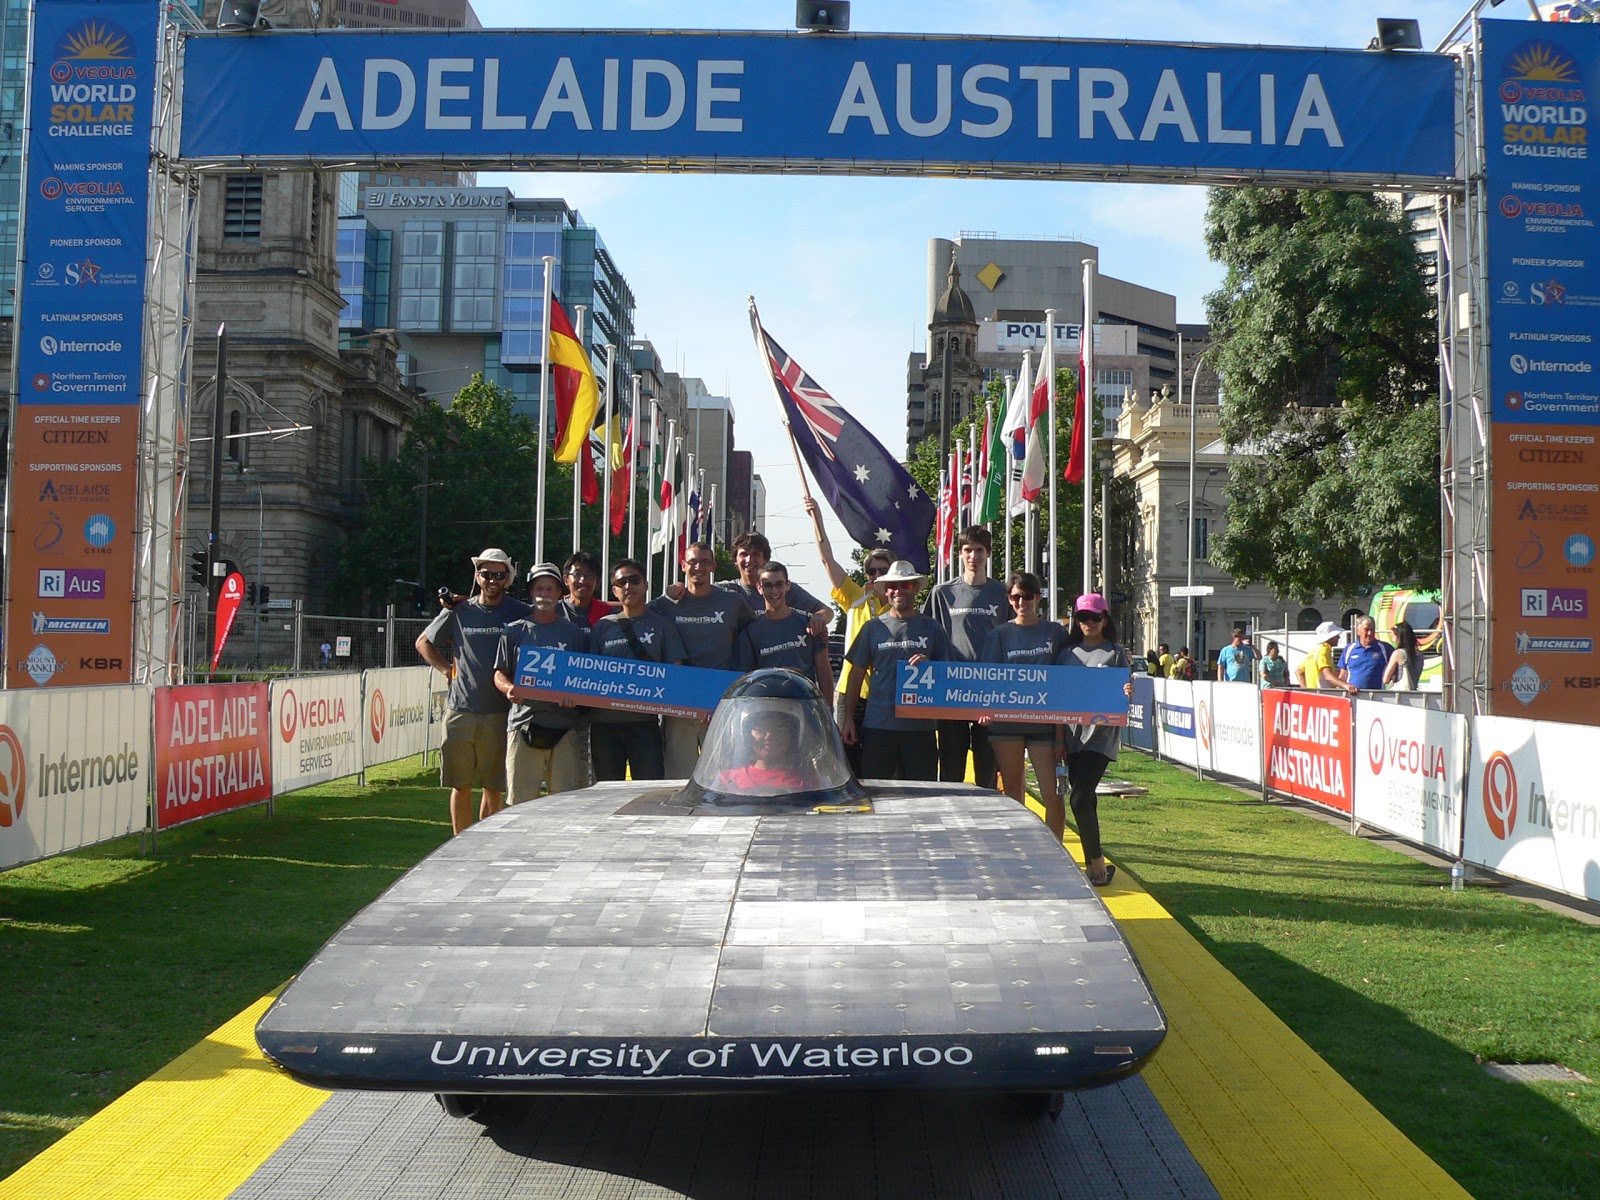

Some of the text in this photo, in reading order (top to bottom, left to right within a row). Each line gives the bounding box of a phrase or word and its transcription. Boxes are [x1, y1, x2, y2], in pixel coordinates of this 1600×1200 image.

[75, 66, 136, 80] VEOLIA
[50, 84, 136, 103] WORLD
[1524, 87, 1585, 102] VEOLIA
[294, 57, 1344, 148] ADELAIDE AUSTRALIA
[50, 104, 134, 123] SOLAR
[1501, 104, 1588, 125] WORLD
[49, 124, 133, 137] CHALLENGE
[1503, 124, 1587, 145] SOLAR
[1503, 144, 1588, 159] CHALLENGE
[54, 163, 123, 171] NAMING SPONSOR
[65, 182, 124, 195] VEOLIA
[1511, 182, 1581, 193] NAMING SPONSOR
[65, 197, 134, 205] ENVIRONMENTAL
[389, 193, 435, 207] ERNST
[436, 195, 446, 207] &
[450, 193, 503, 208] YOUNG
[1523, 202, 1584, 217] VEOLIA
[1525, 217, 1595, 227] ENVIRONMENTAL
[1525, 225, 1566, 233] SERVICES
[50, 238, 122, 247] PIONEER SPONSOR
[1512, 257, 1584, 268] PIONEER SPONSOR
[41, 313, 124, 322] PLATINUM SPONSORS
[1509, 332, 1592, 343] PLATINUM SPONSORS
[60, 339, 122, 352] Internode
[1530, 359, 1592, 373] Internode
[52, 372, 127, 382] Northern Territory
[52, 382, 127, 392] Government
[1524, 391, 1599, 403] Northern Territory
[1524, 400, 1600, 413] Government
[34, 416, 121, 424] OFFICIAL TIME KEEPER
[43, 430, 109, 444] CITIZEN
[1509, 434, 1595, 444] OFFICIAL TIME KEEPER
[1519, 449, 1584, 463] CITIZEN
[29, 463, 122, 472] SUPPORTING SPONSORS
[39, 479, 111, 501] ADELAIDE
[1507, 482, 1599, 492] SUPPORTING SPONSORS
[43, 575, 101, 593] Ri Aus
[1526, 595, 1583, 612] Ri Aus
[47, 621, 107, 630] MICHELIN
[1531, 640, 1590, 649] MICHELIN
[17, 661, 64, 672] FRANKLIN
[80, 658, 122, 670] KBR
[523, 651, 666, 679] 24 MIDNIGHT SUN
[903, 665, 1047, 690] 24 MIDNIGHT SUN
[536, 675, 666, 699] CAN Midnight Sun X
[917, 689, 1049, 707] CAN Midnight Sun X
[300, 697, 345, 729] VEOLIA
[389, 699, 424, 728] Internode
[611, 701, 698, 718] www.worldsolarchallenge.org
[170, 696, 257, 747] ADELAIDE
[993, 711, 1083, 723] www.worldsolarchallenge.org
[1273, 701, 1339, 748] ADELAIDE
[300, 730, 355, 754] ENVIRONMENTAL
[300, 753, 332, 773] SERVICES
[1388, 736, 1447, 783] VEOLIA
[39, 742, 138, 797] Internode
[1270, 744, 1345, 799] AUSTRALIA
[165, 748, 264, 809] AUSTRALIA
[1528, 781, 1600, 839] Intern
[430, 1040, 974, 1075] University of Waterloo
